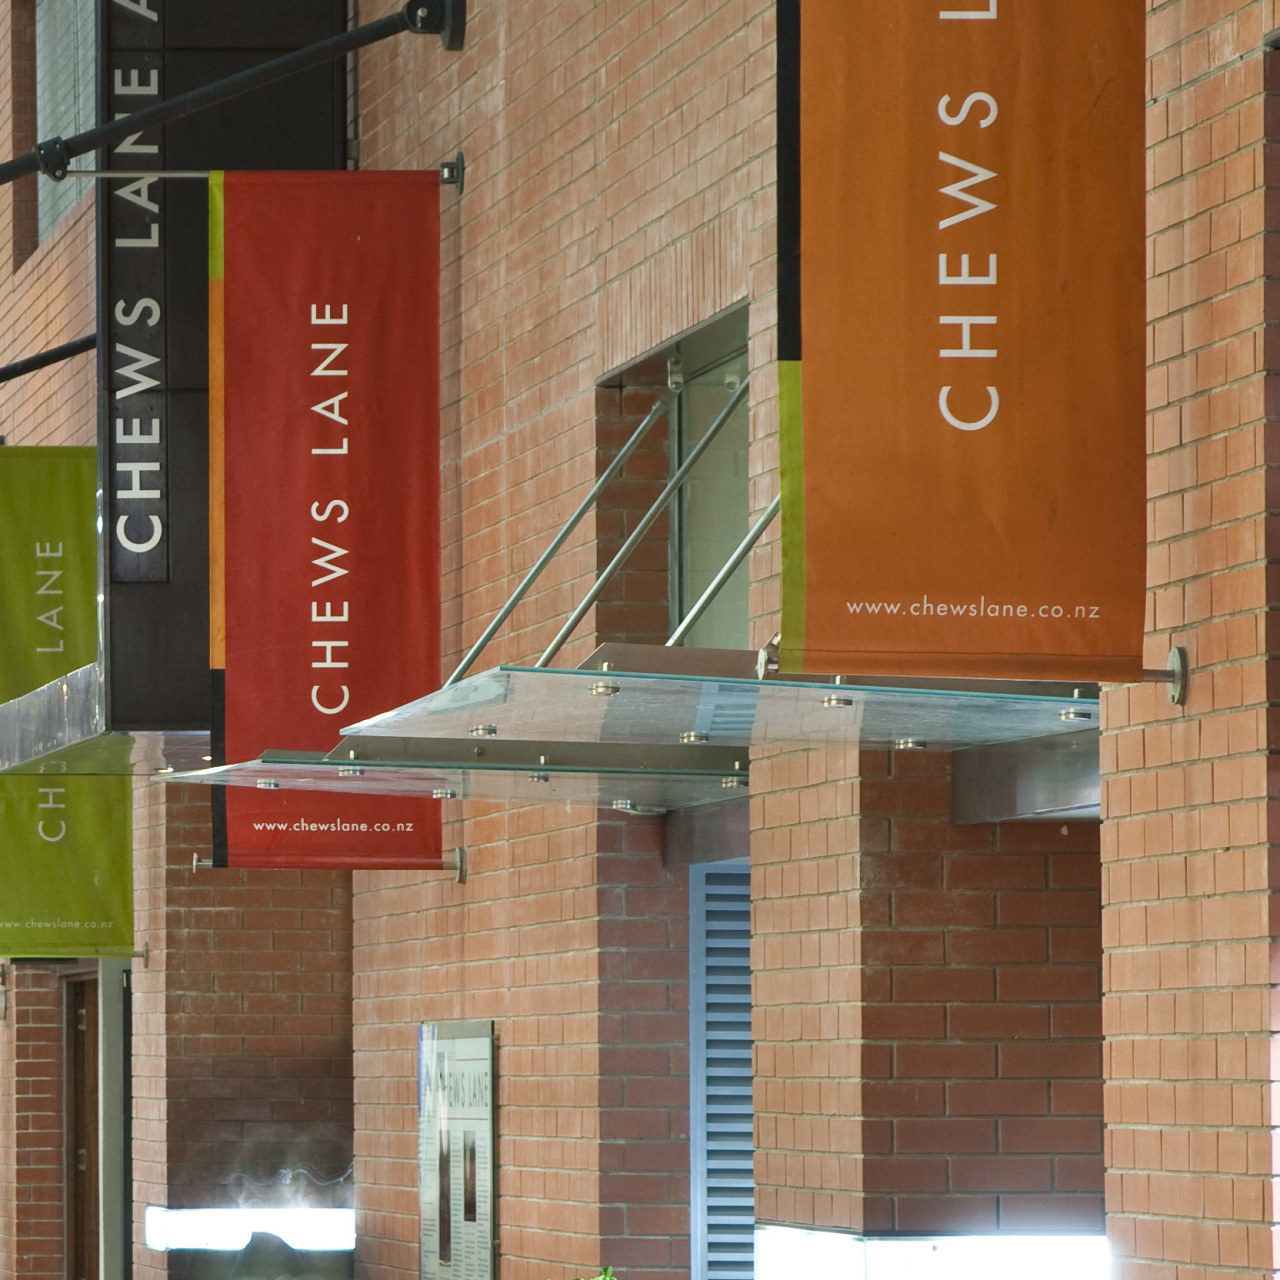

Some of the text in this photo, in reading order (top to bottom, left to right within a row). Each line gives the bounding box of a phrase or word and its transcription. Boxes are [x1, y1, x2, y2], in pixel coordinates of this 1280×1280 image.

[937, 91, 999, 431] CHEWS
[115, 297, 162, 554] CHEWS
[310, 303, 350, 715] CHEWS LANE
[35, 541, 64, 653] LANE
[846, 594, 1101, 619] www.chewslane.co.nz
[252, 817, 414, 832] www.chewslane.co.nz
